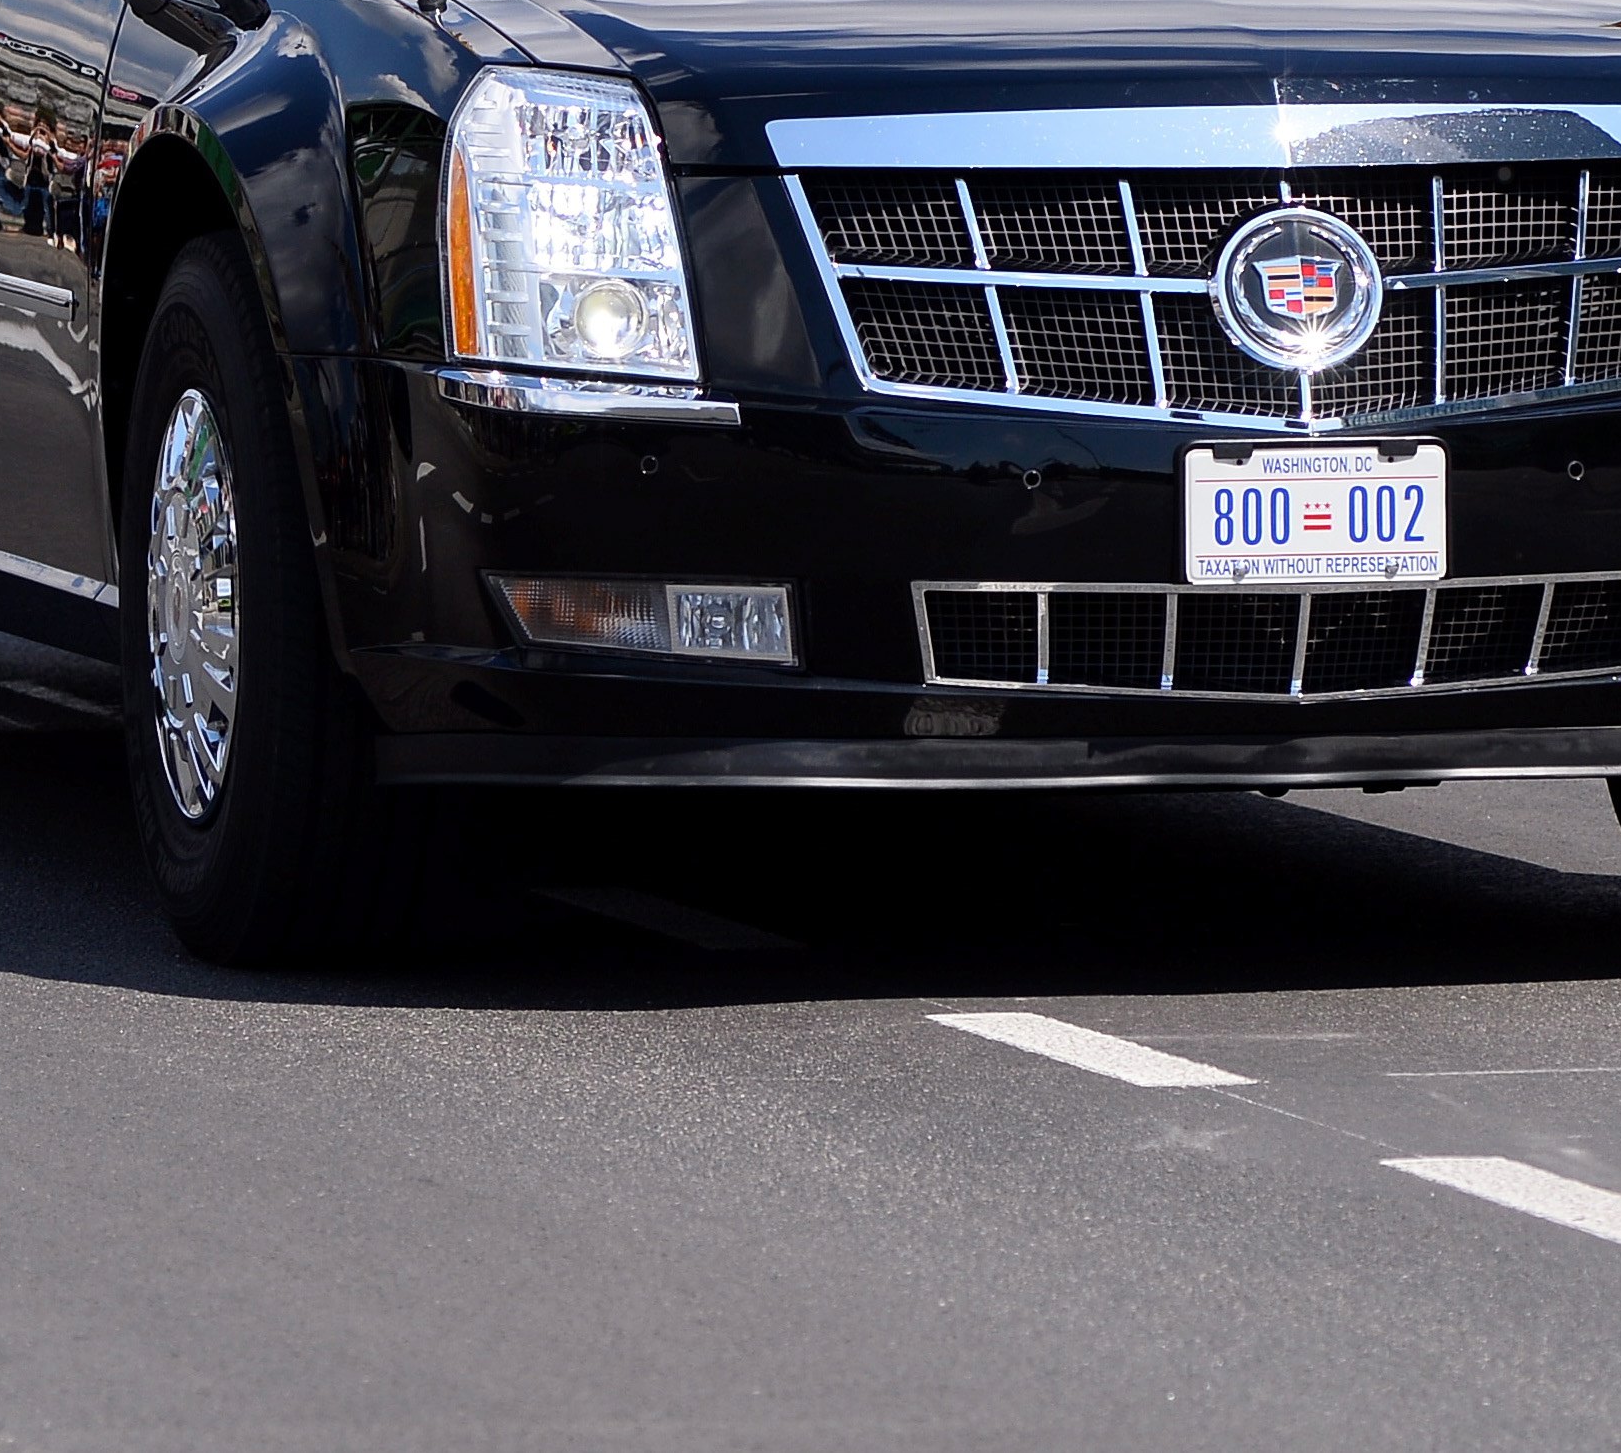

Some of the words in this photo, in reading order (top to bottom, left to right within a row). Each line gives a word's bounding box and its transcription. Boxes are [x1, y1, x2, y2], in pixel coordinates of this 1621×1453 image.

[1262, 458, 1351, 474] WASHINGTON,
[1356, 457, 1372, 473] DC
[1214, 488, 1290, 545] 800
[1349, 485, 1425, 543] 002
[1198, 559, 1260, 576] TAXATON
[1263, 558, 1322, 575] WITHOUT
